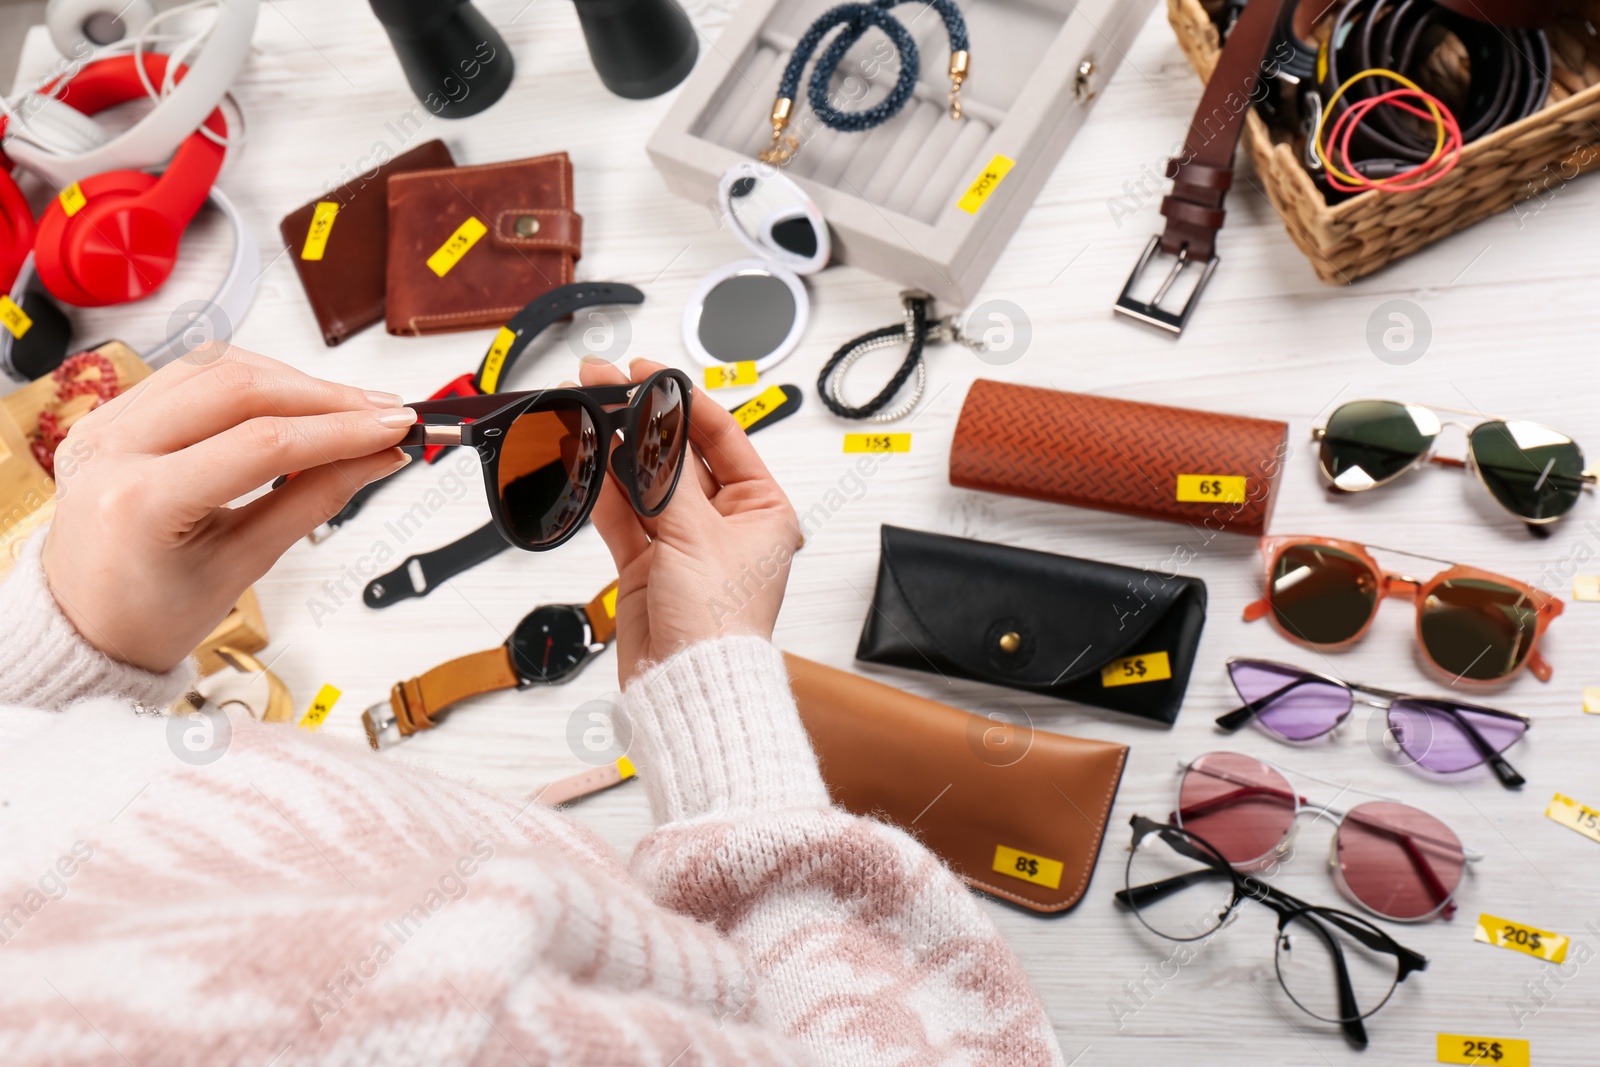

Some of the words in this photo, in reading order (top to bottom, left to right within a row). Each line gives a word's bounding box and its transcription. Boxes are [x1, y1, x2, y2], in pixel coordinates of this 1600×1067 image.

[972, 172, 997, 197] 20$
[446, 235, 468, 256] 15$
[719, 367, 737, 383] 5$
[739, 400, 766, 423] 25$
[865, 436, 891, 449] 15$
[1199, 480, 1222, 497] 6$
[1122, 658, 1147, 678] 5$
[1015, 856, 1039, 878] 8$
[1502, 925, 1541, 952] 20$
[1463, 1041, 1503, 1063] 25$
